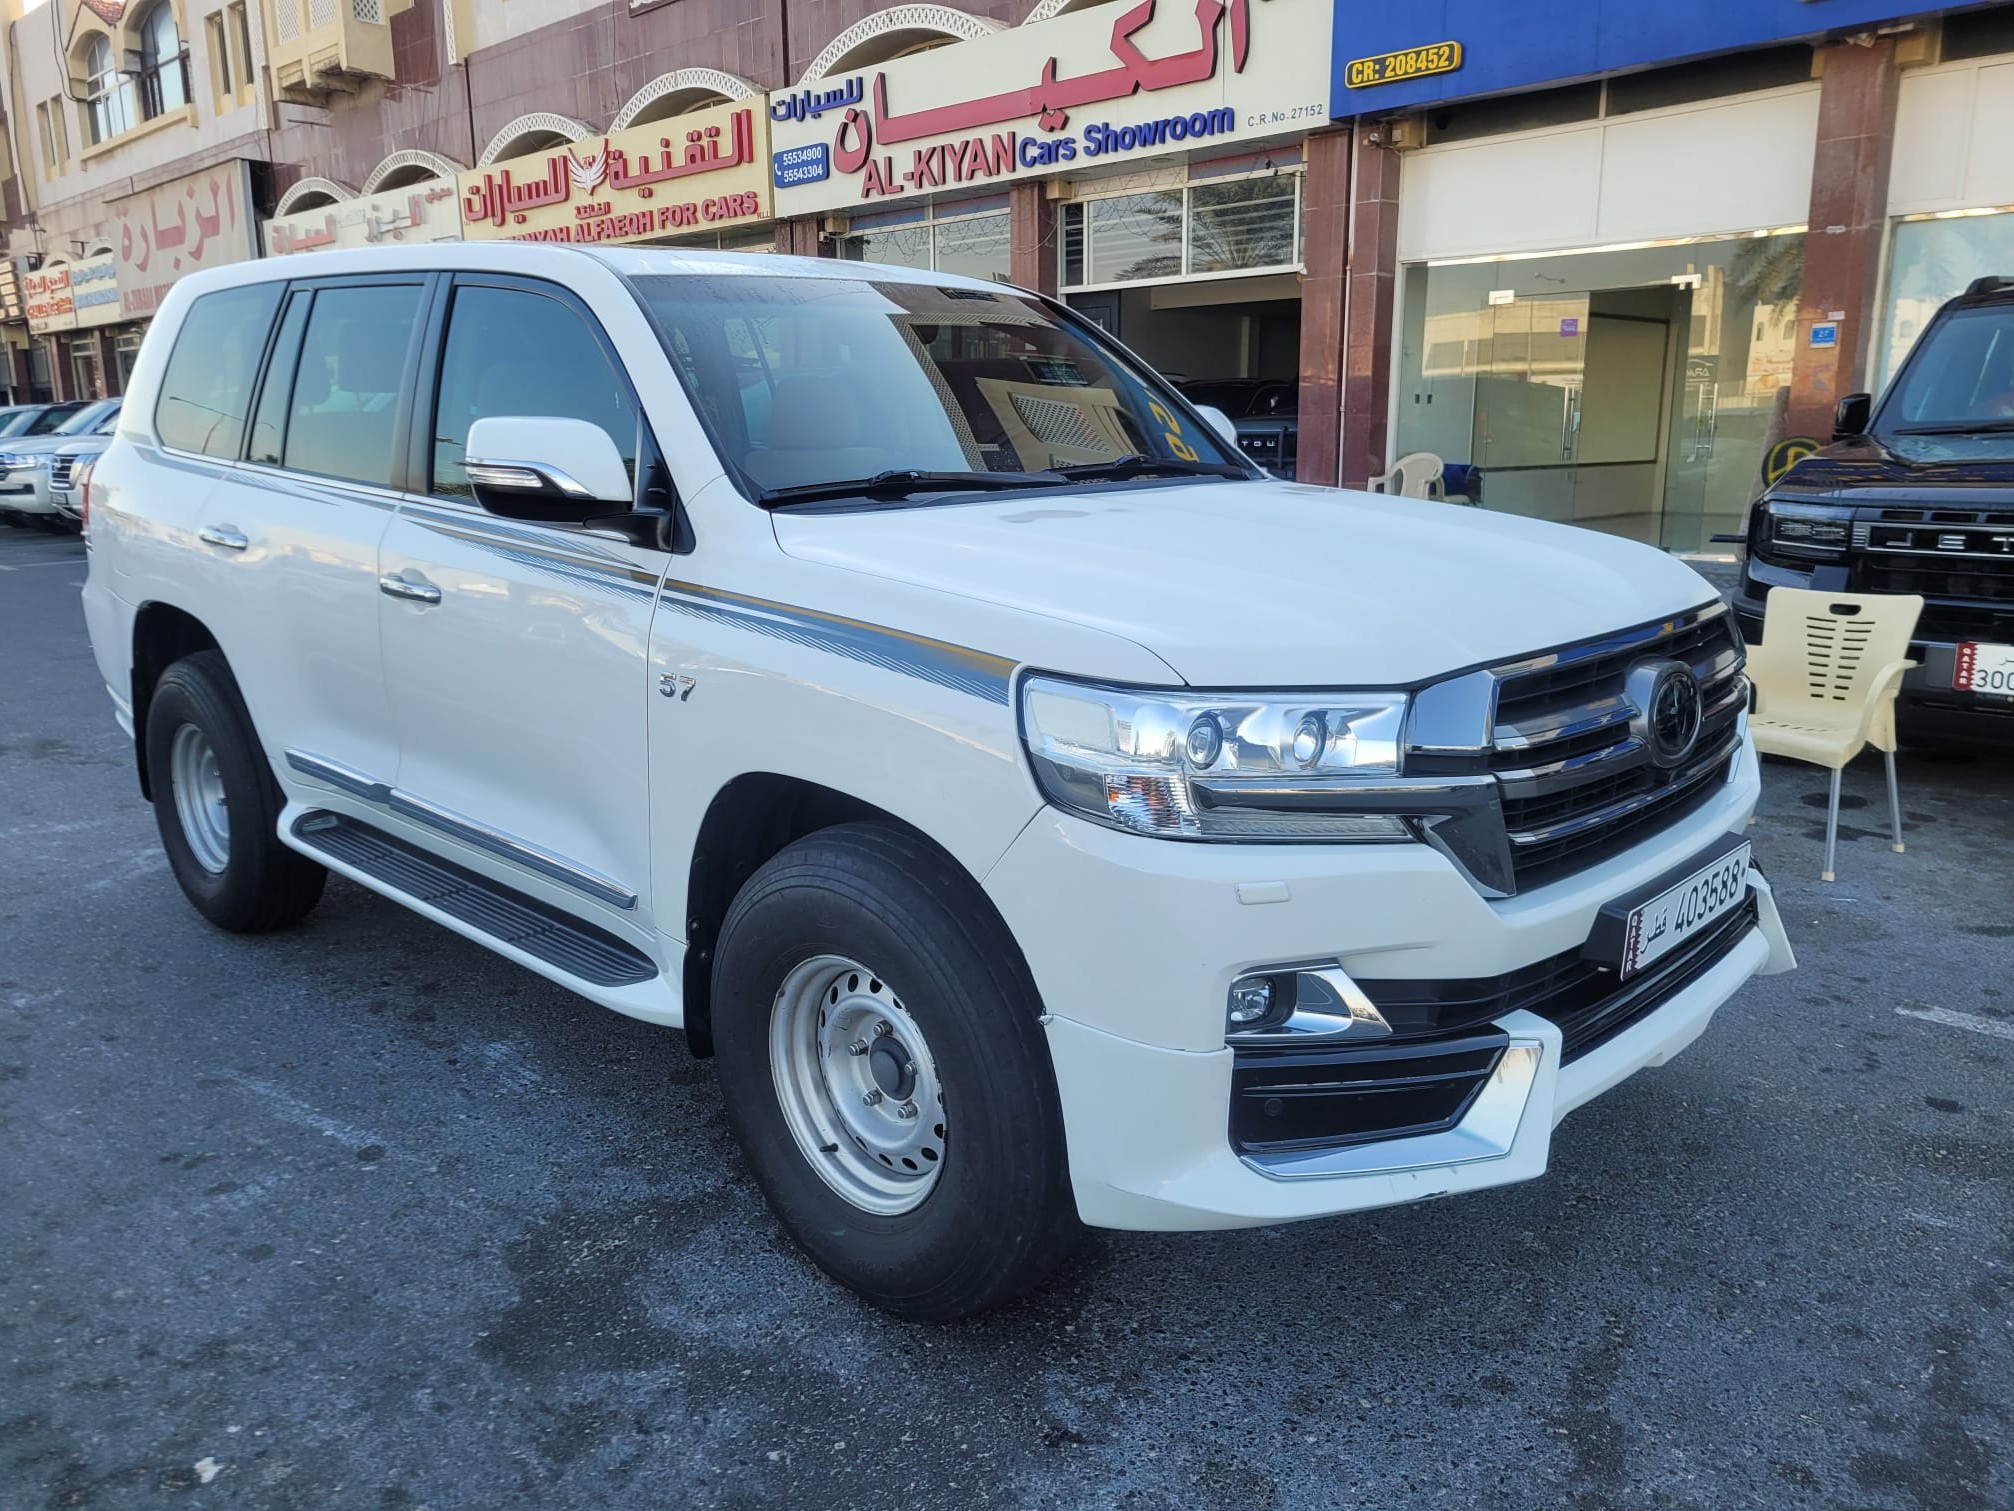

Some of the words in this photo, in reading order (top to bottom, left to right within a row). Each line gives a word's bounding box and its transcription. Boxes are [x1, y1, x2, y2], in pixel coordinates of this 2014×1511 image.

[834, 0, 1249, 174] الكيان
[1351, 63, 1379, 84] CR:
[1385, 46, 1450, 78] 208452
[769, 76, 863, 122] للسيارات
[609, 109, 754, 198] التقنية
[783, 146, 822, 165] 55534900
[783, 163, 823, 182] 55543304
[861, 131, 1016, 198] AL-KIYAN
[1018, 136, 1076, 168] Cars
[1083, 106, 1235, 157] Showroom
[463, 155, 572, 226] للسيارات
[574, 210, 655, 243] ALFAEQH
[657, 201, 699, 230] FOR
[701, 190, 758, 222] CARS
[1640, 906, 1668, 954] قطر
[1674, 858, 1741, 934] 403588
[1626, 914, 1638, 973] QATAR
